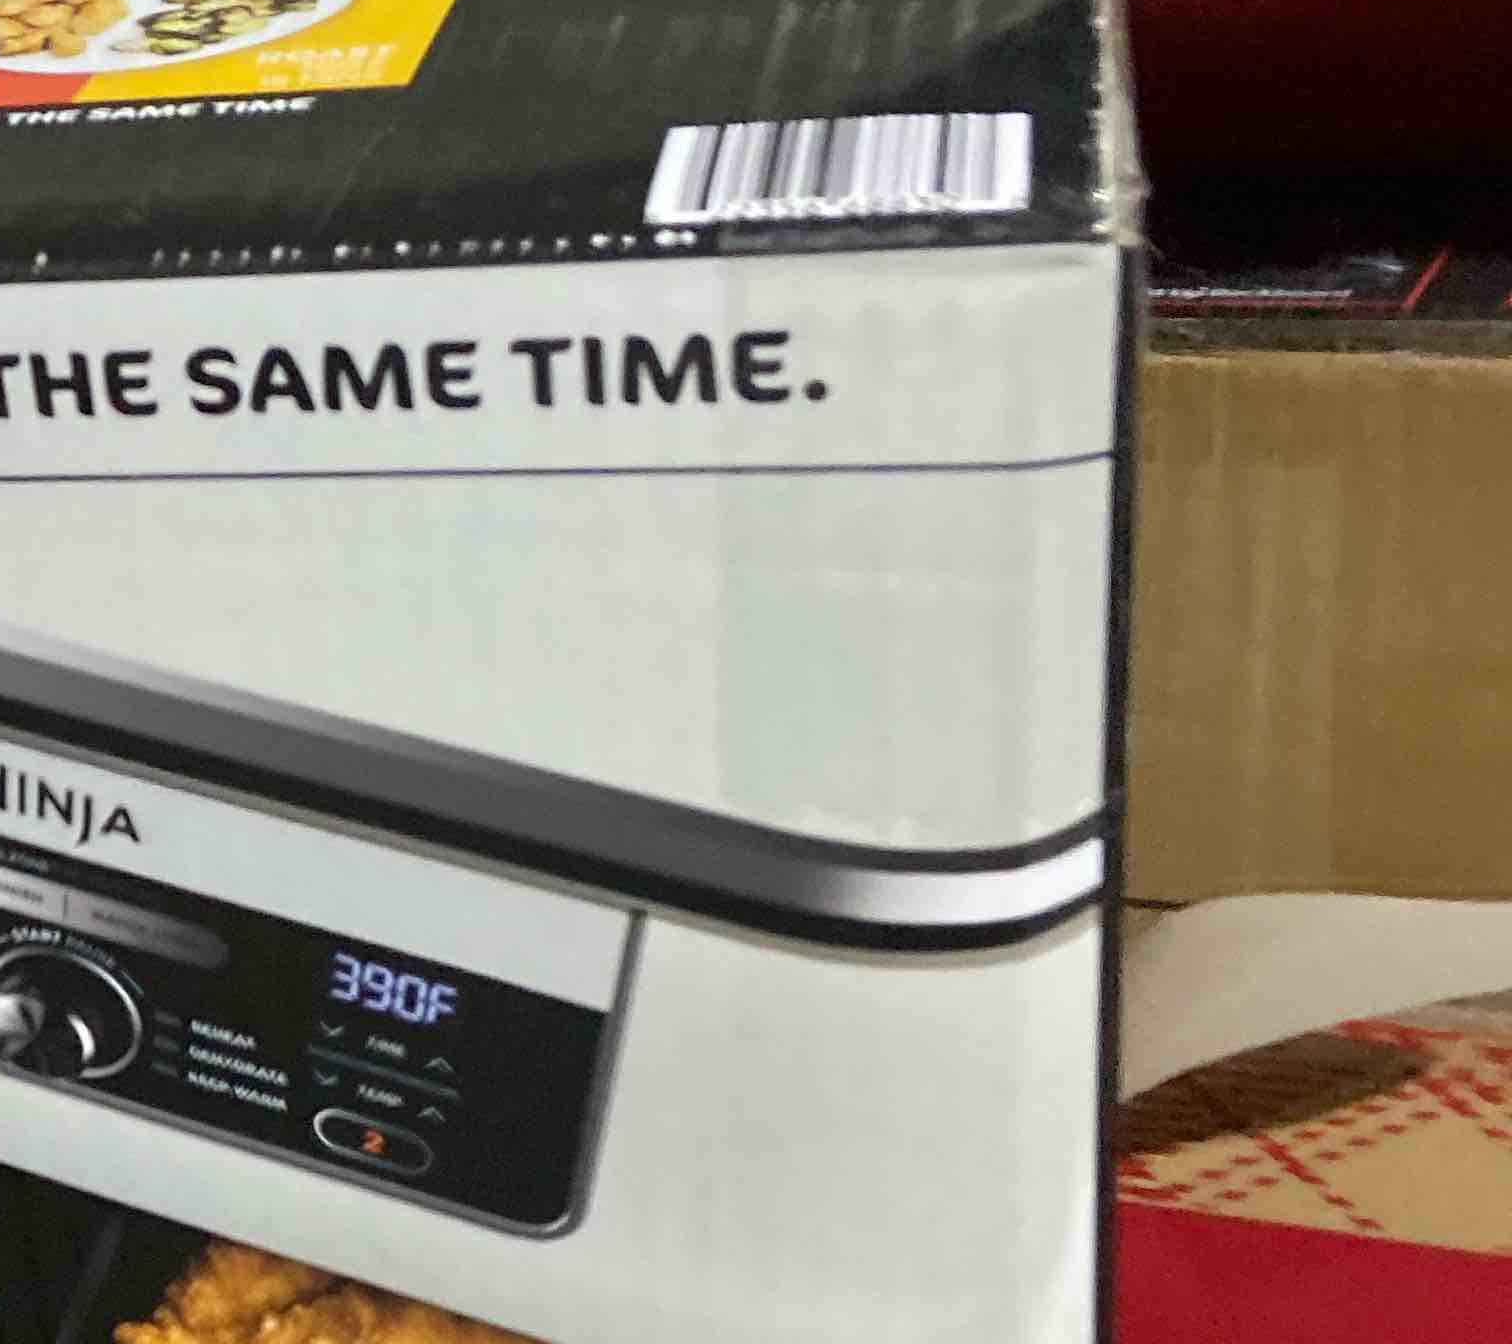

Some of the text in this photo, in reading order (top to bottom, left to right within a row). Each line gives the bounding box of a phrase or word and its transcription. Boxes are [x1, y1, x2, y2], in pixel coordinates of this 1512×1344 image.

[6, 108, 80, 126] THE
[87, 102, 203, 121] SAME
[211, 95, 320, 116] TIME
[188, 341, 483, 414] SAME
[507, 331, 830, 407] TIME.
[330, 952, 458, 1025] 390F
